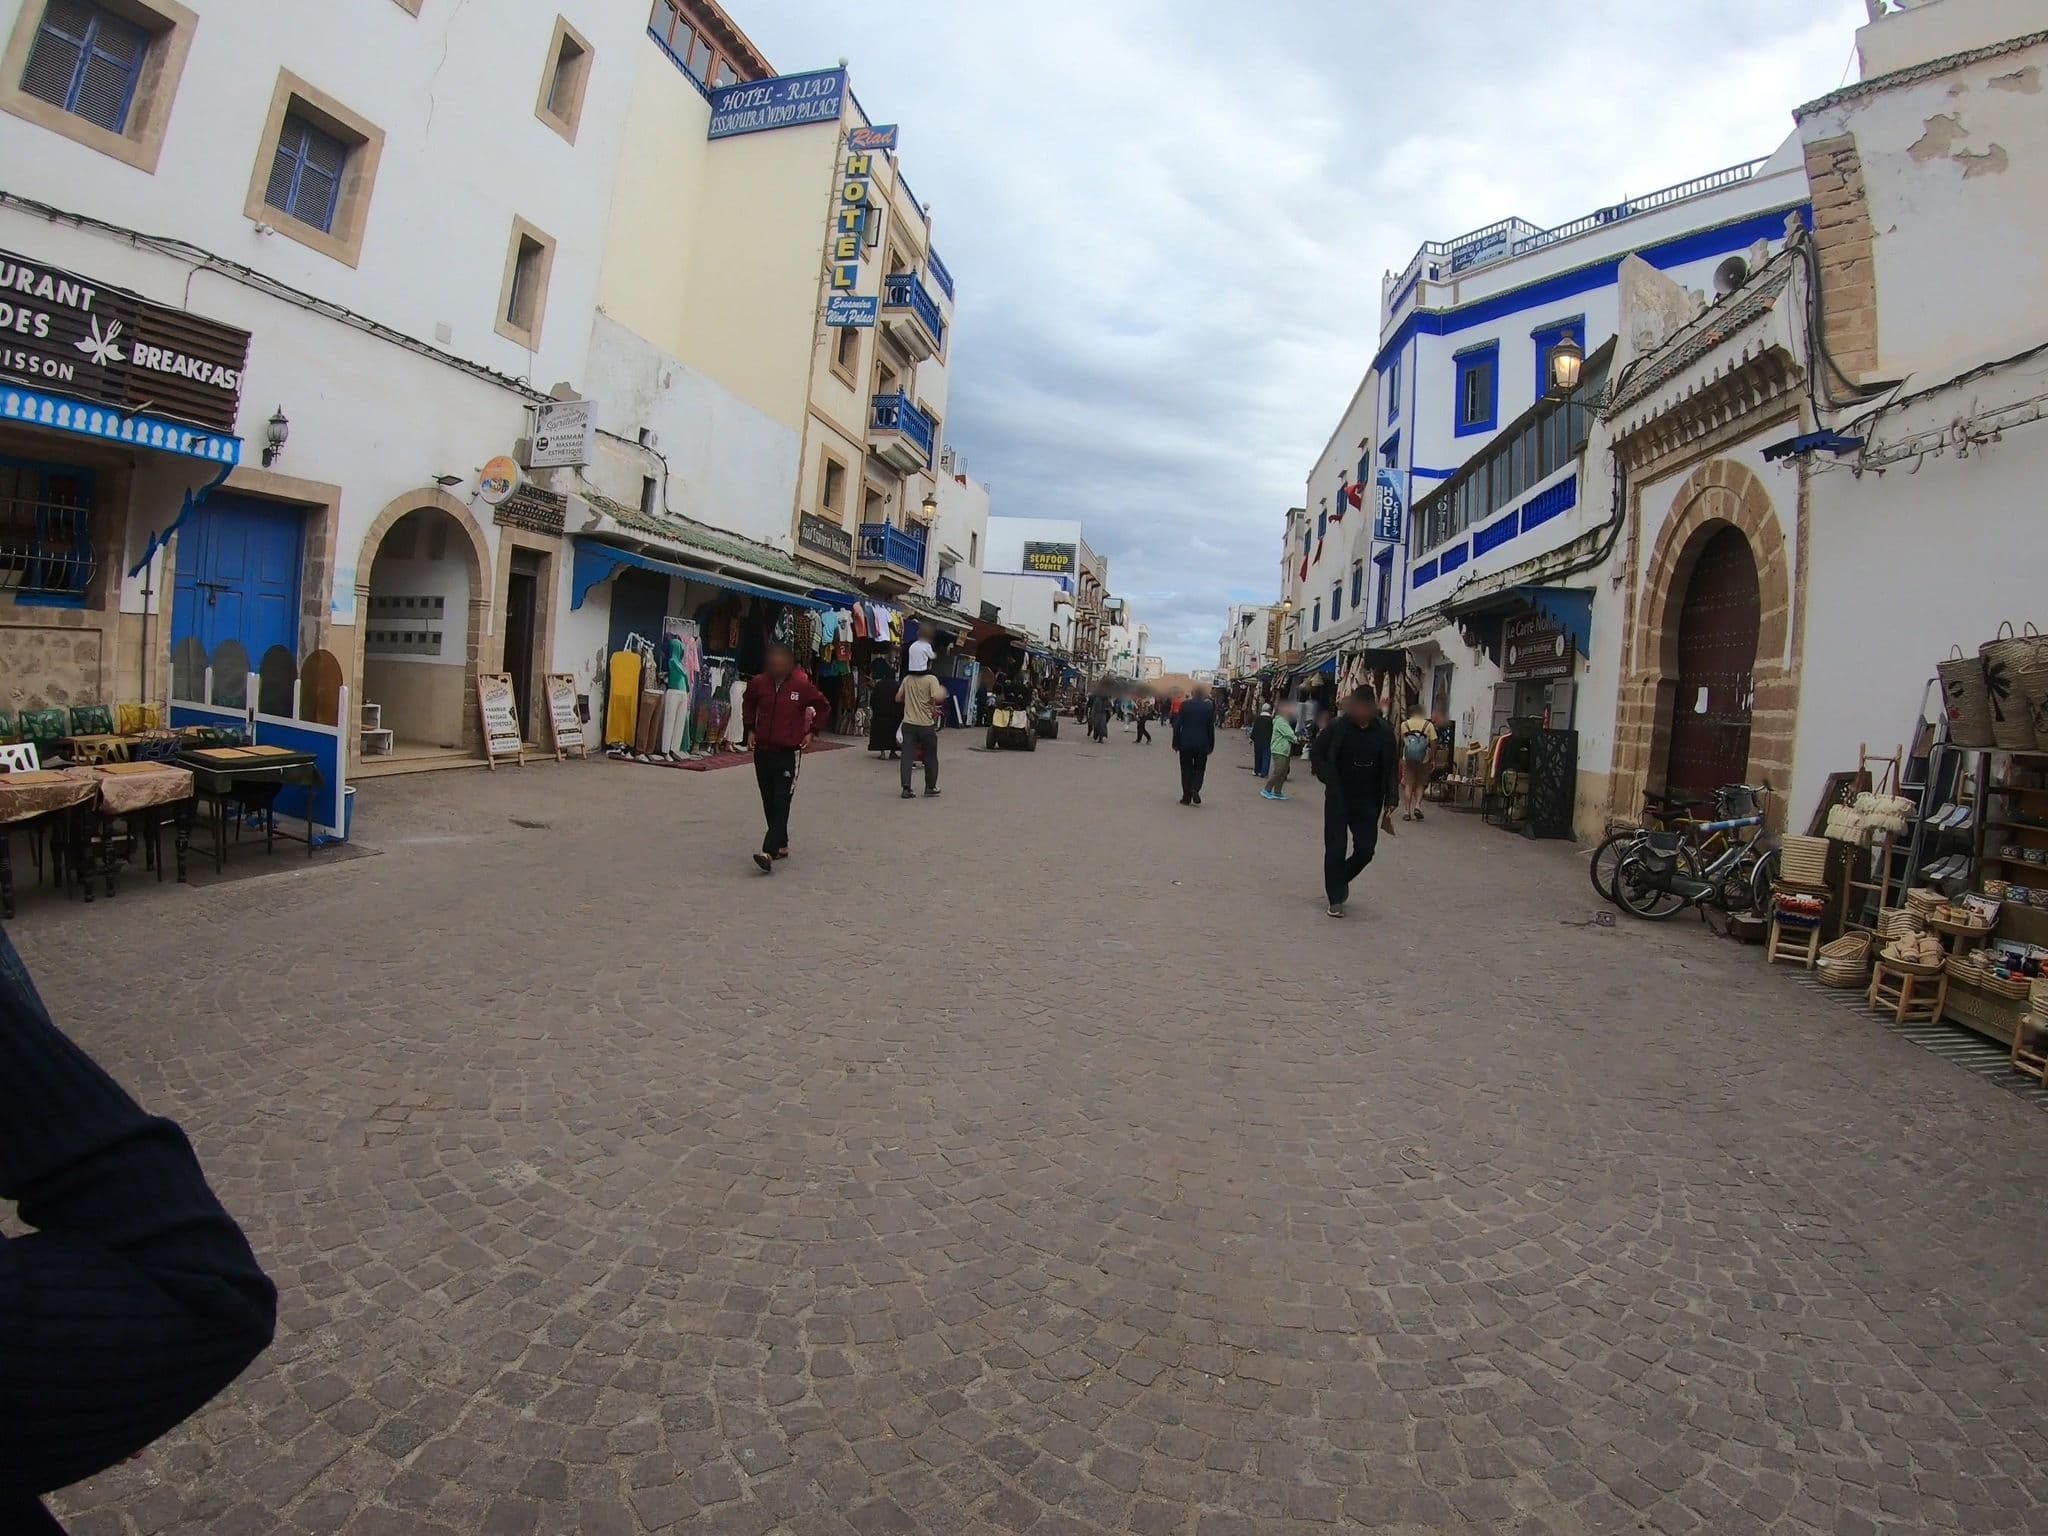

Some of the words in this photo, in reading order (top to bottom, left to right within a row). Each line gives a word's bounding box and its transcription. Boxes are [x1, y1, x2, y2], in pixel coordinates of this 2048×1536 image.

[720, 86, 774, 112] HOTEL
[787, 77, 837, 101] RIAD
[710, 109, 766, 134] ESSAOUIRA
[767, 103, 797, 124] WIND
[797, 97, 840, 119] PALACE
[850, 128, 895, 147] Riad
[834, 155, 869, 286] HOTEL
[827, 309, 849, 323] Wind
[847, 308, 874, 324] Palace
[0, 349, 74, 381] ISSON
[550, 433, 584, 441] HAMMAM
[556, 440, 583, 448] MASSAGE
[1383, 486, 1393, 537] HOTEL
[1030, 554, 1069, 565] SEAFOOD
[1507, 623, 1515, 639] Le
